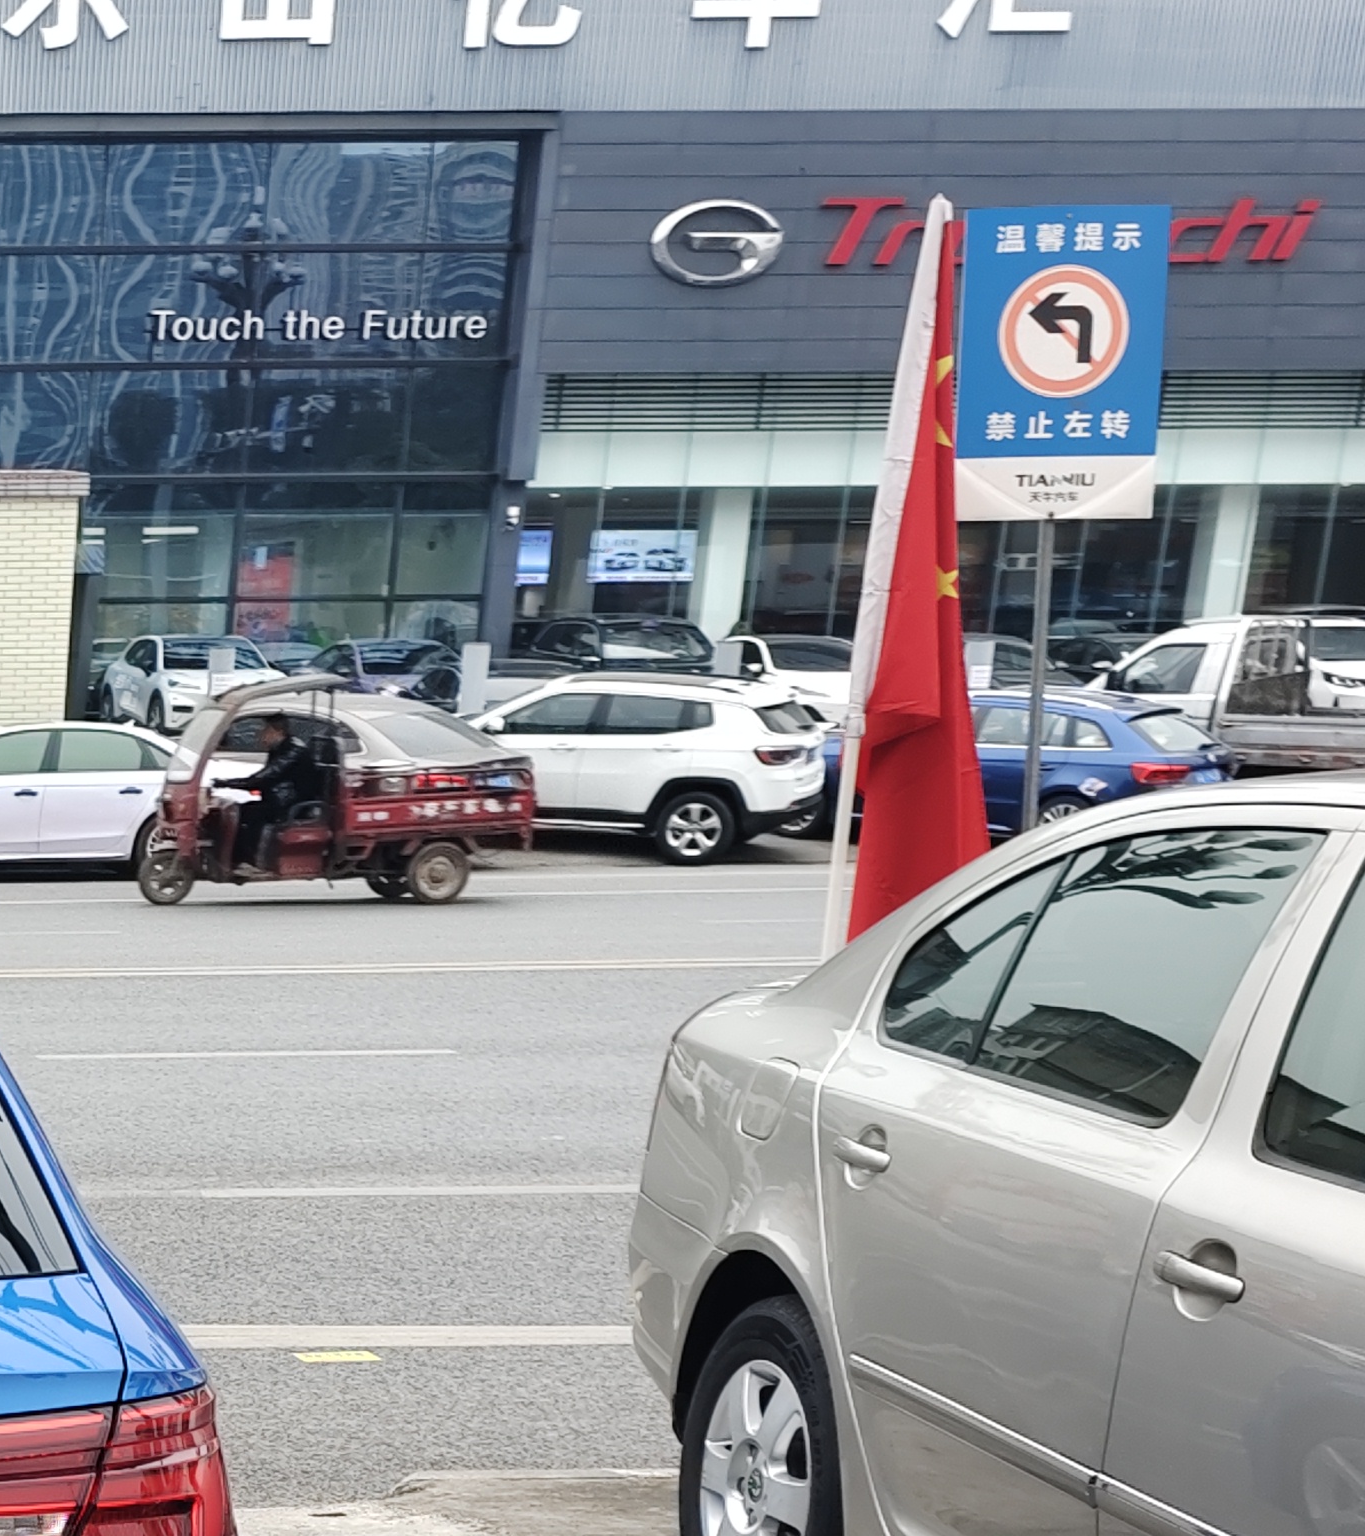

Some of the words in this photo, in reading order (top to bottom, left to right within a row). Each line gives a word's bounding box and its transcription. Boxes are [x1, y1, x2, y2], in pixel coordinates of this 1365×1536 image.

[822, 197, 1321, 267] Trchi
[995, 222, 1142, 254] 温馨提示
[150, 309, 265, 342] Touch
[282, 309, 345, 341] the
[361, 310, 488, 341] Future
[985, 409, 1131, 441] 禁止左转
